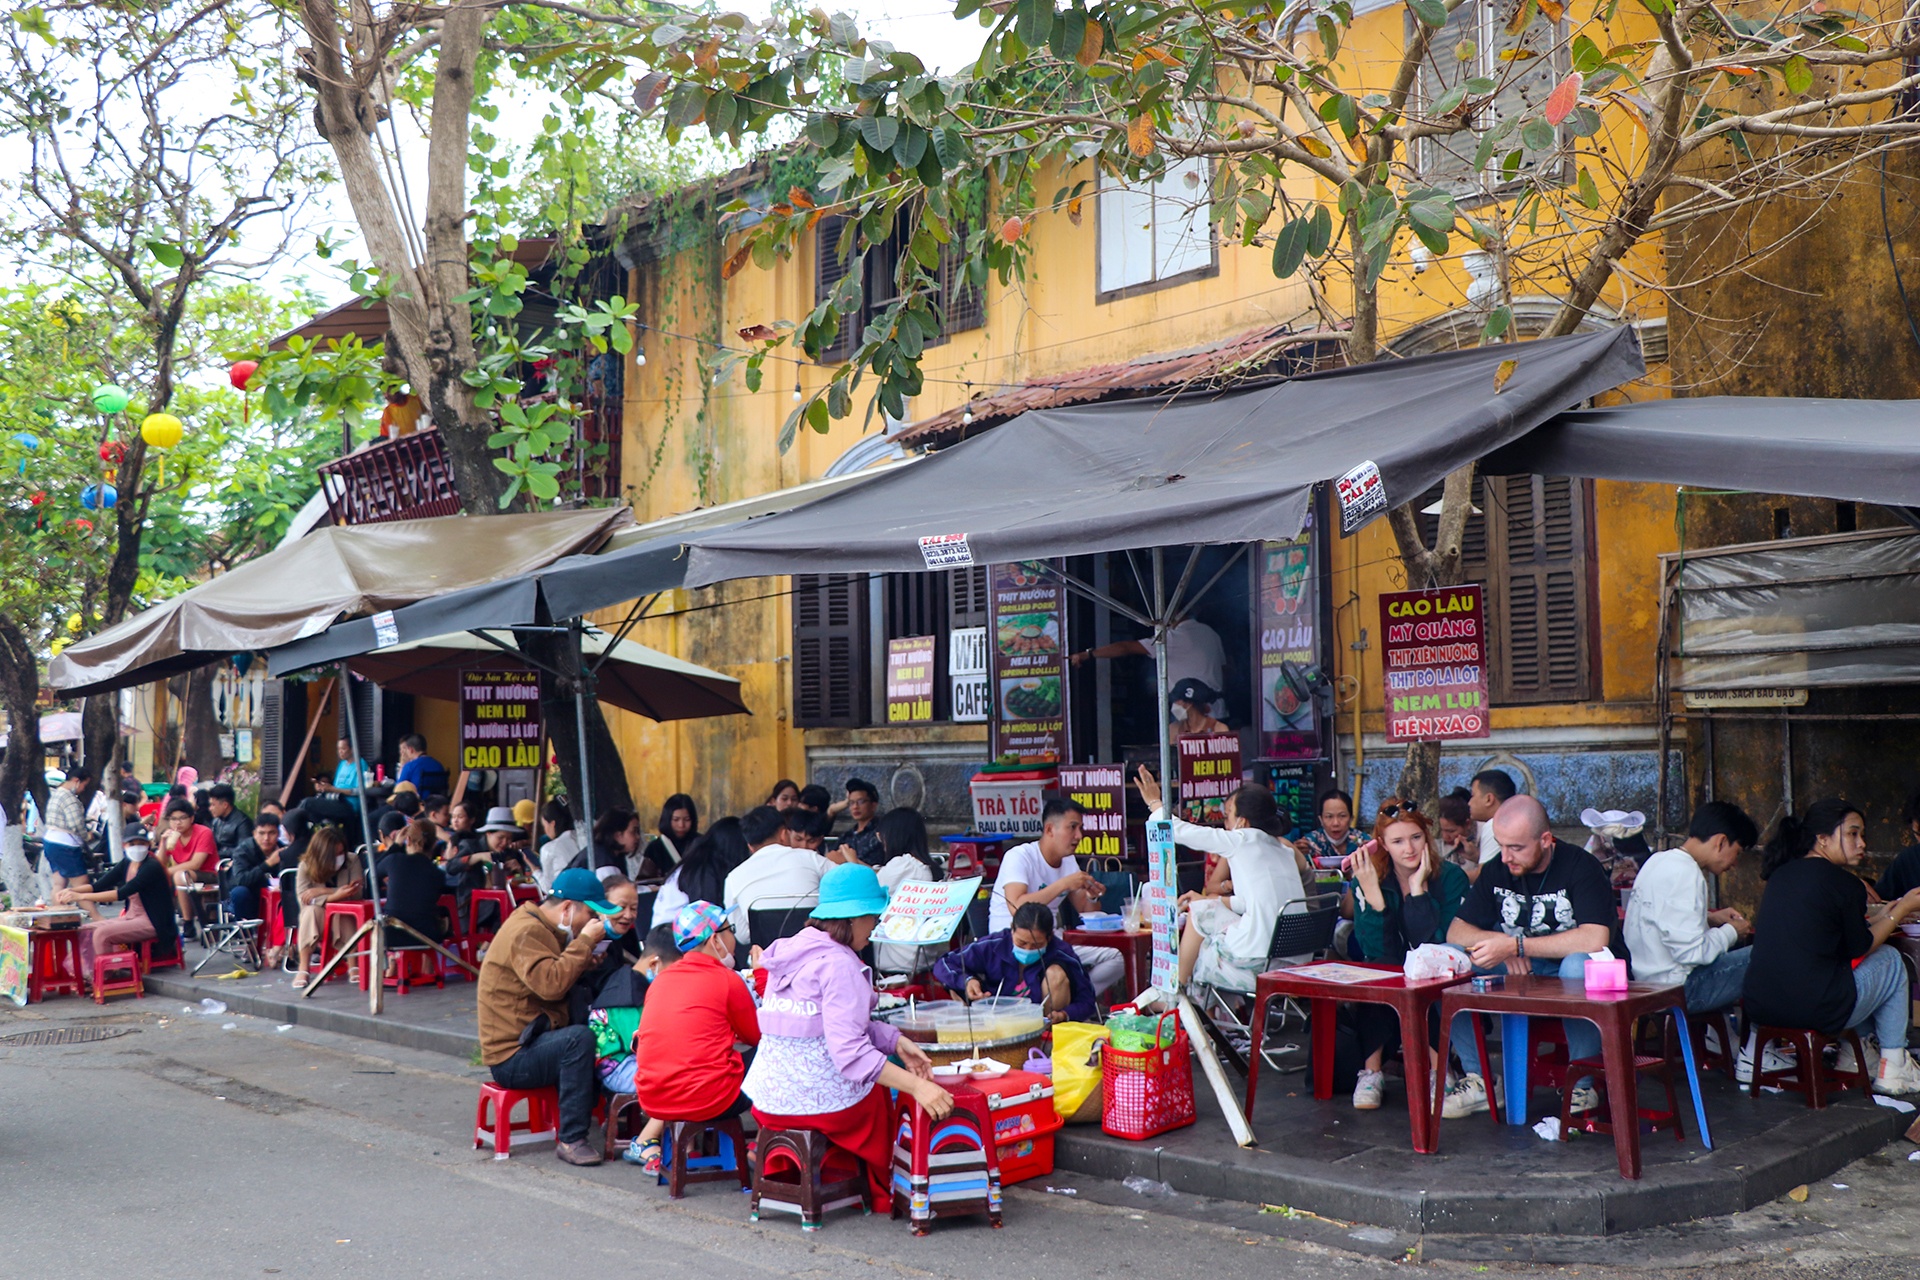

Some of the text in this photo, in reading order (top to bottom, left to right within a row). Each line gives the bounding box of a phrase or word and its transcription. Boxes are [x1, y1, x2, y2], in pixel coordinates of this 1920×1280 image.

[1388, 599, 1432, 618] CAO
[1415, 617, 1476, 641] QUẢNG
[1261, 628, 1286, 651] CAO
[1010, 656, 1031, 666] NEM
[1388, 648, 1412, 668] THỊT
[1389, 671, 1414, 690] THỊT
[464, 686, 493, 702] THỊT
[1393, 691, 1480, 712] NEM LỤI
[477, 704, 526, 720] NEM LỤI
[889, 702, 910, 722] CAO
[464, 738, 540, 768] CAO LẦU
[1180, 740, 1206, 758] THỊT
[1193, 758, 1232, 776] NEM LỤI
[1279, 766, 1303, 776] DIVING
[1060, 770, 1084, 790] THỊT
[977, 790, 1039, 816] TRÀ TẮC
[1094, 792, 1112, 811] LỤI
[978, 820, 998, 833] RAU
[1074, 830, 1120, 855] AO LẦU
[1494, 886, 1526, 904] PLEASE
